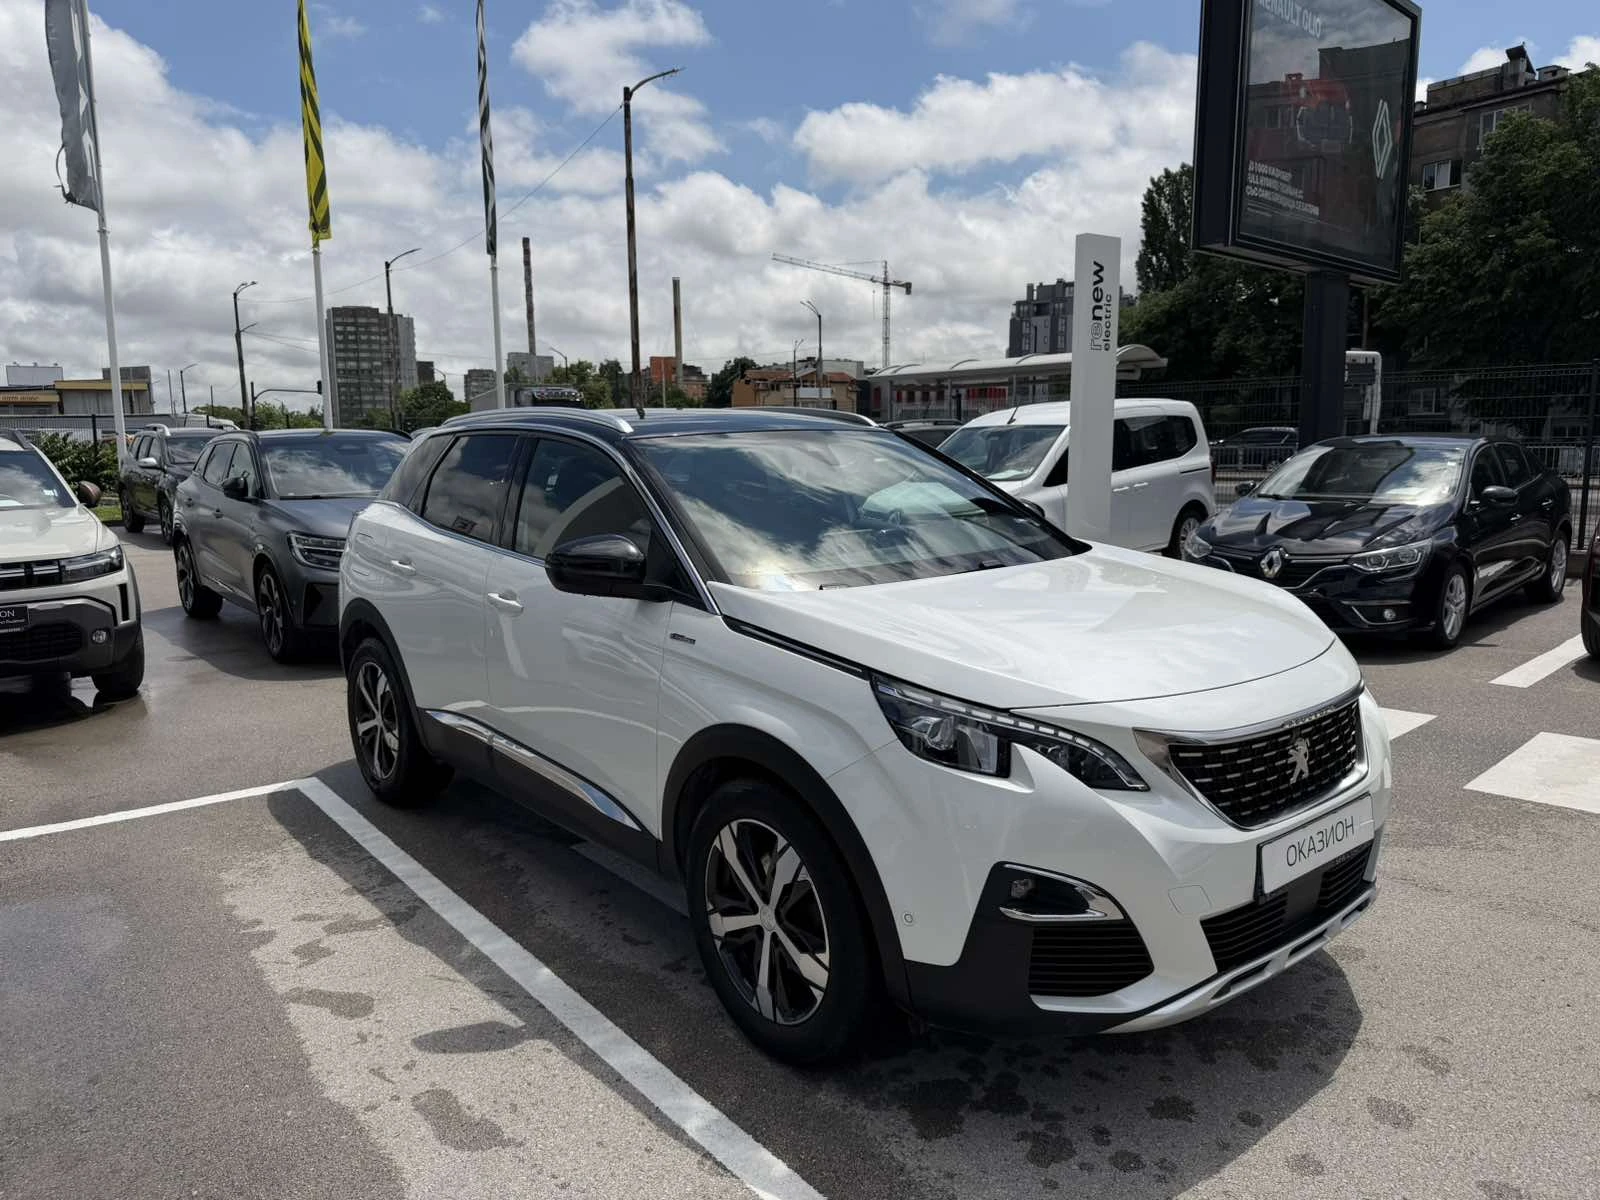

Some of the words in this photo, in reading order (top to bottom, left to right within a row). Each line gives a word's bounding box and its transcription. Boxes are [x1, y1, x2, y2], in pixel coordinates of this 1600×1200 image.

[1090, 261, 1105, 351] renew
[1102, 294, 1113, 352] electric
[1286, 815, 1355, 867] ОКАЗИОН
